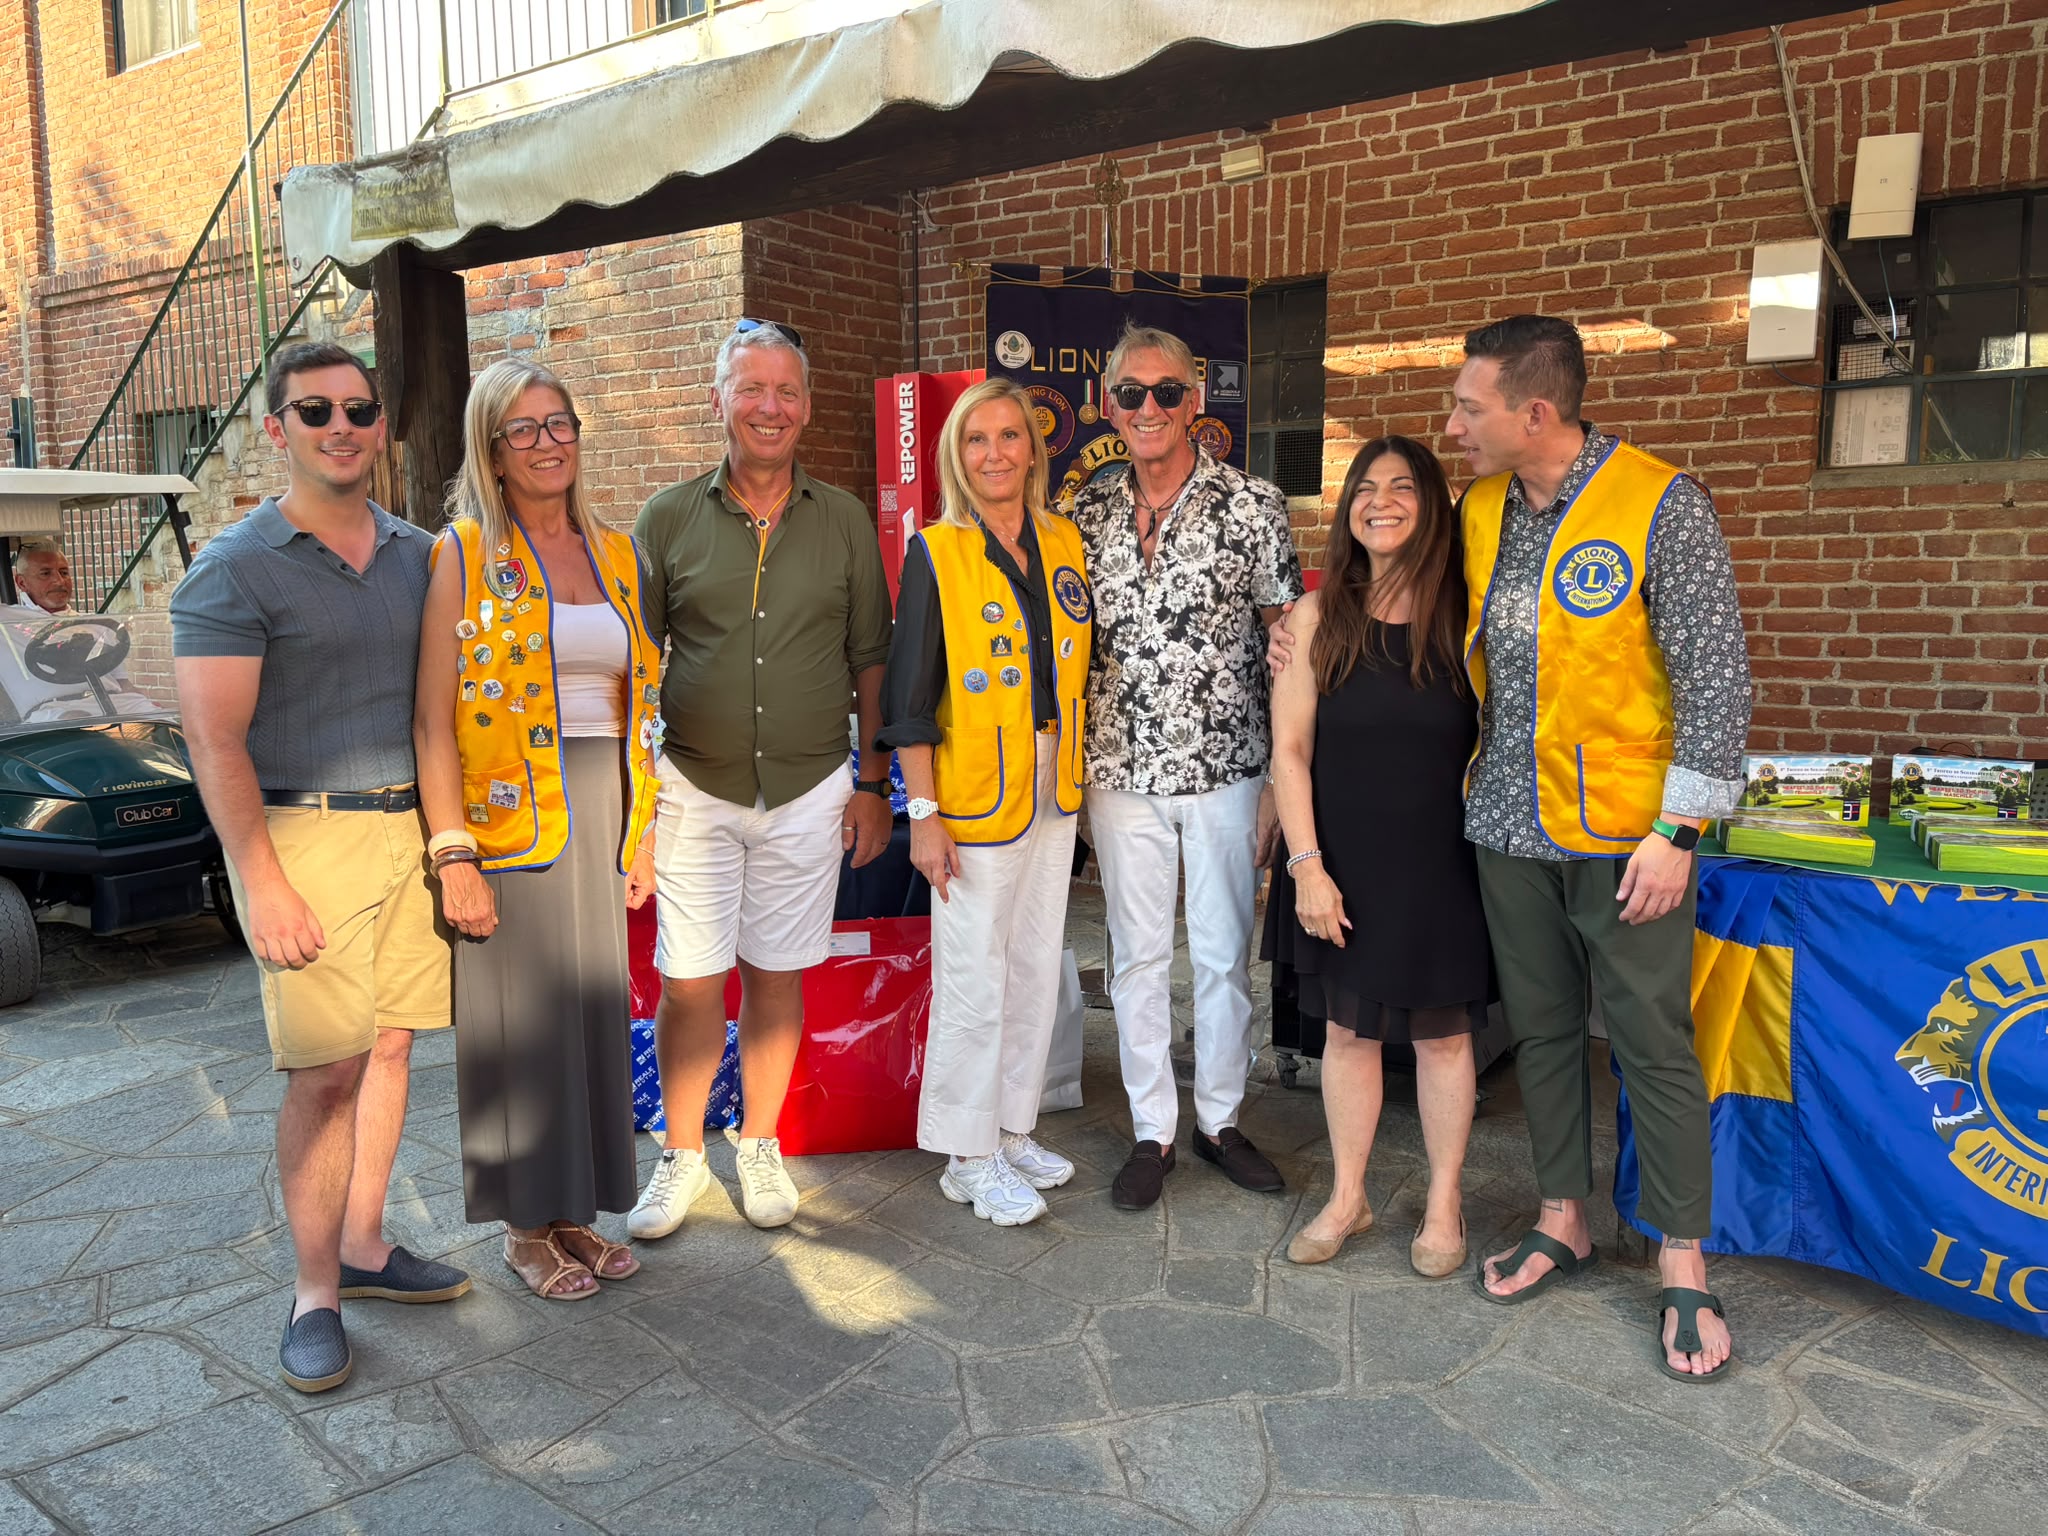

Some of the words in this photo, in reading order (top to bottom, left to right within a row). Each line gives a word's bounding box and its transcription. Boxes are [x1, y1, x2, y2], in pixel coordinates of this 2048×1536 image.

[1048, 391, 1067, 411] LION
[1036, 408, 1048, 419] 25
[899, 381, 916, 484] REPOWER
[1089, 439, 1131, 462] LIO
[1577, 548, 1617, 562] LIONS
[1584, 566, 1602, 588] L
[1571, 593, 1609, 605] INTERNATIONAL
[123, 809, 152, 822] Club
[152, 806, 174, 818] Car
[635, 1066, 655, 1084] REALE
